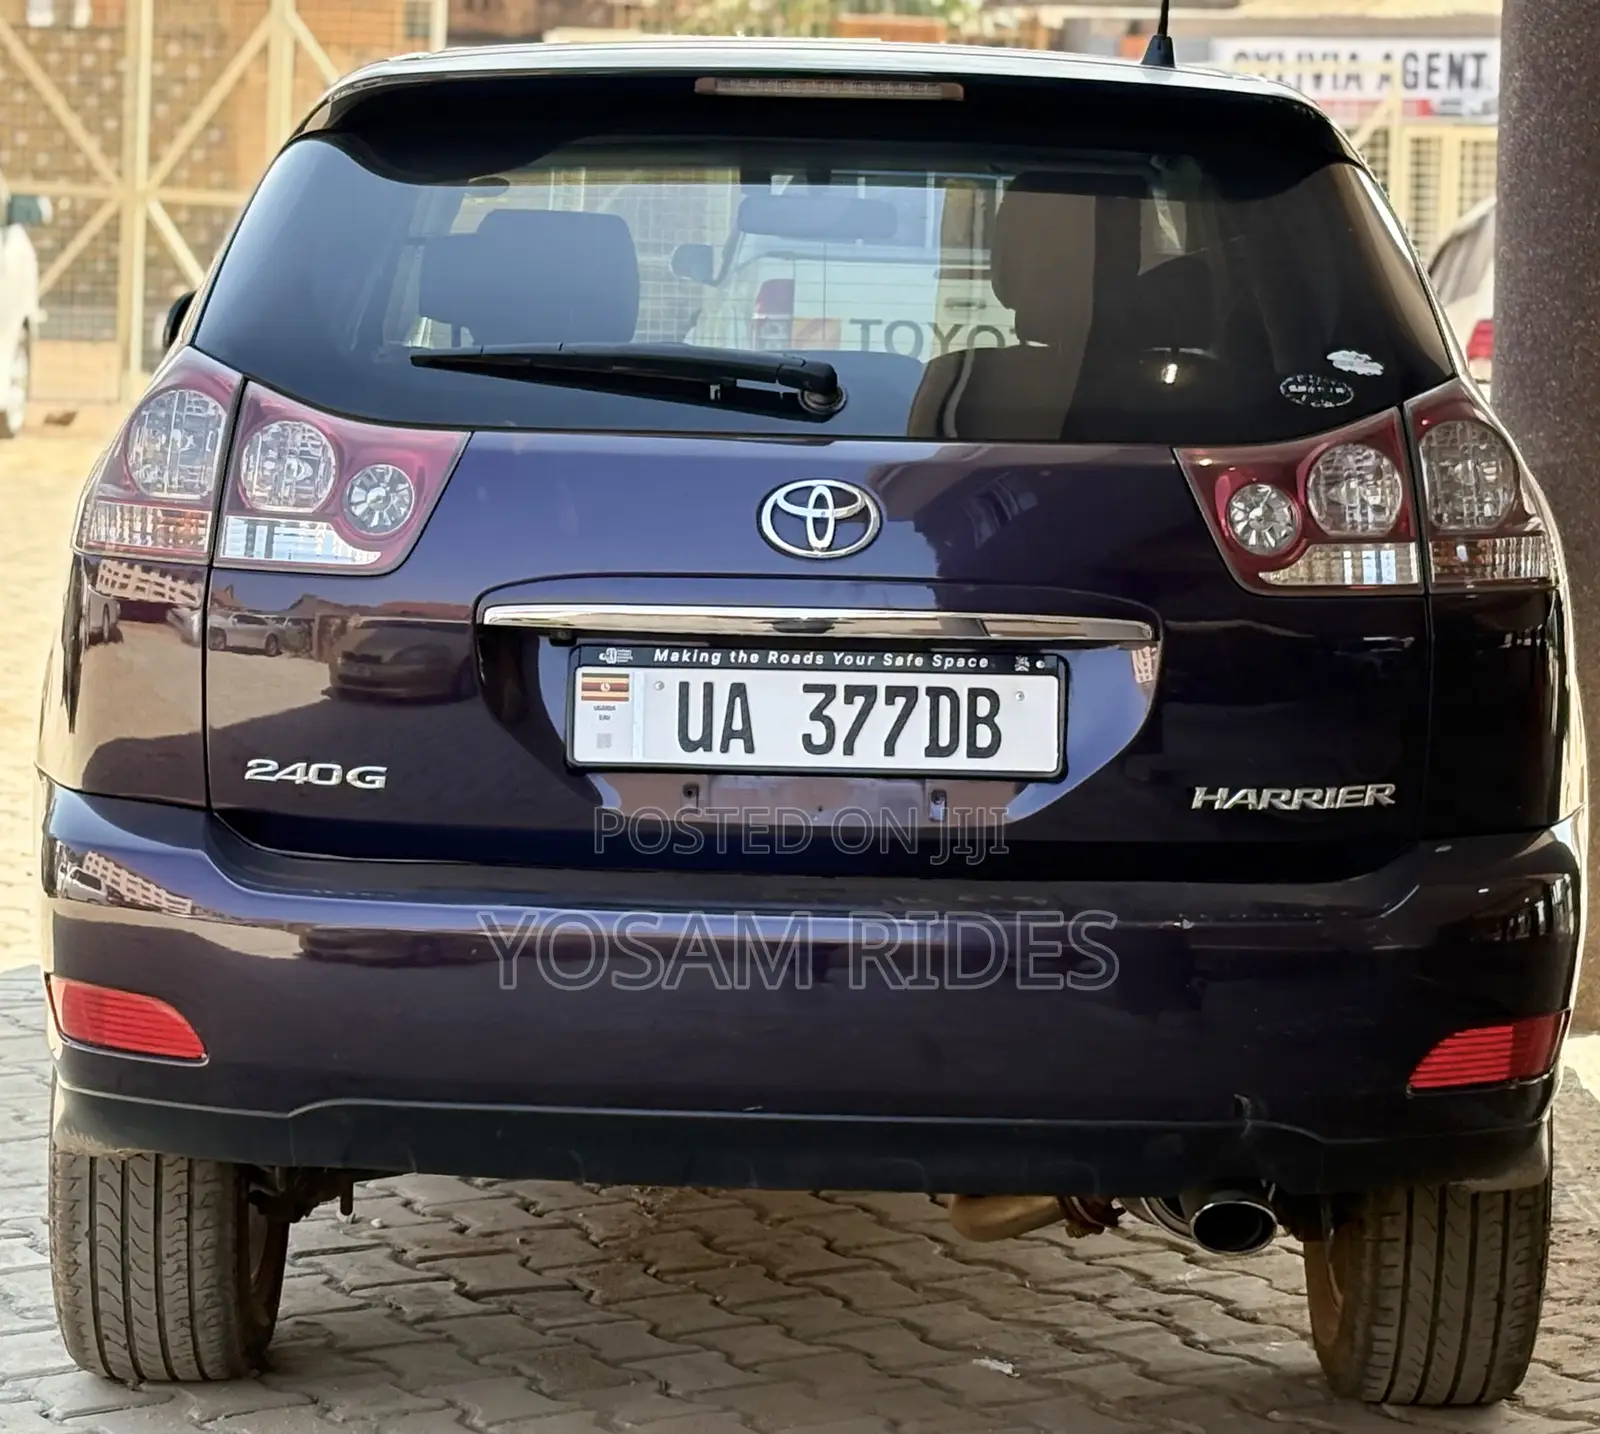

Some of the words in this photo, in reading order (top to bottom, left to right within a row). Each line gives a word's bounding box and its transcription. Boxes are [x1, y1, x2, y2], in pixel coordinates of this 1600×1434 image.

[1376, 51, 1489, 91] AGENT
[849, 318, 1016, 358] TOYO
[653, 648, 722, 667] Making
[729, 649, 760, 665] the
[767, 651, 825, 667] Roads
[833, 653, 877, 668] Your
[882, 654, 924, 669] Safe
[932, 655, 989, 671] Space
[677, 680, 755, 754] UA
[801, 683, 1001, 759] 377DB
[1191, 783, 1396, 810] HARRIER
